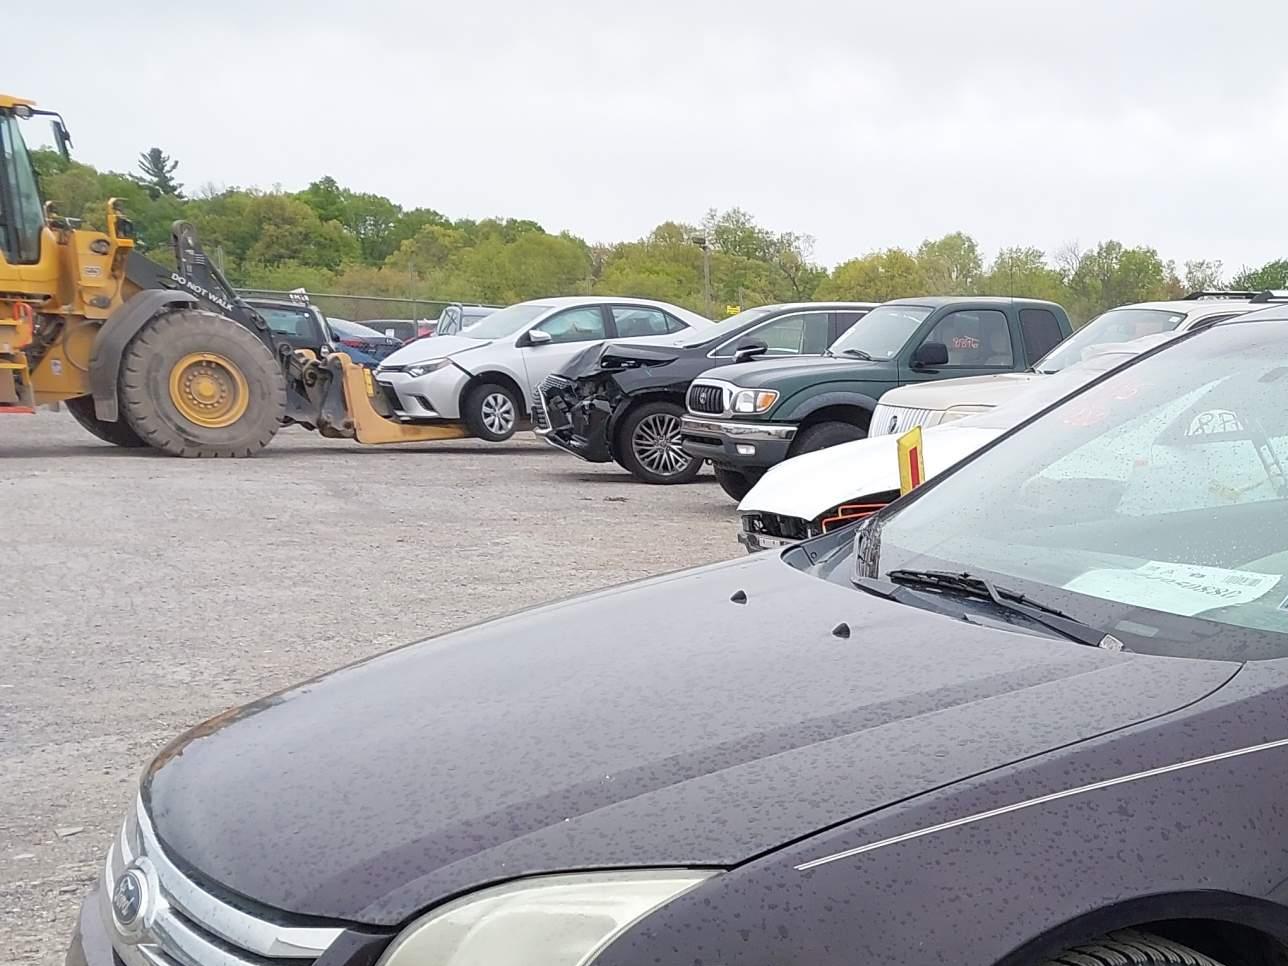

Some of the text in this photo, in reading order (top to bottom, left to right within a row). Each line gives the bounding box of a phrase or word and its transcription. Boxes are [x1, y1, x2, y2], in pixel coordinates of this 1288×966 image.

[171, 272, 235, 312] DO NOT WALK
